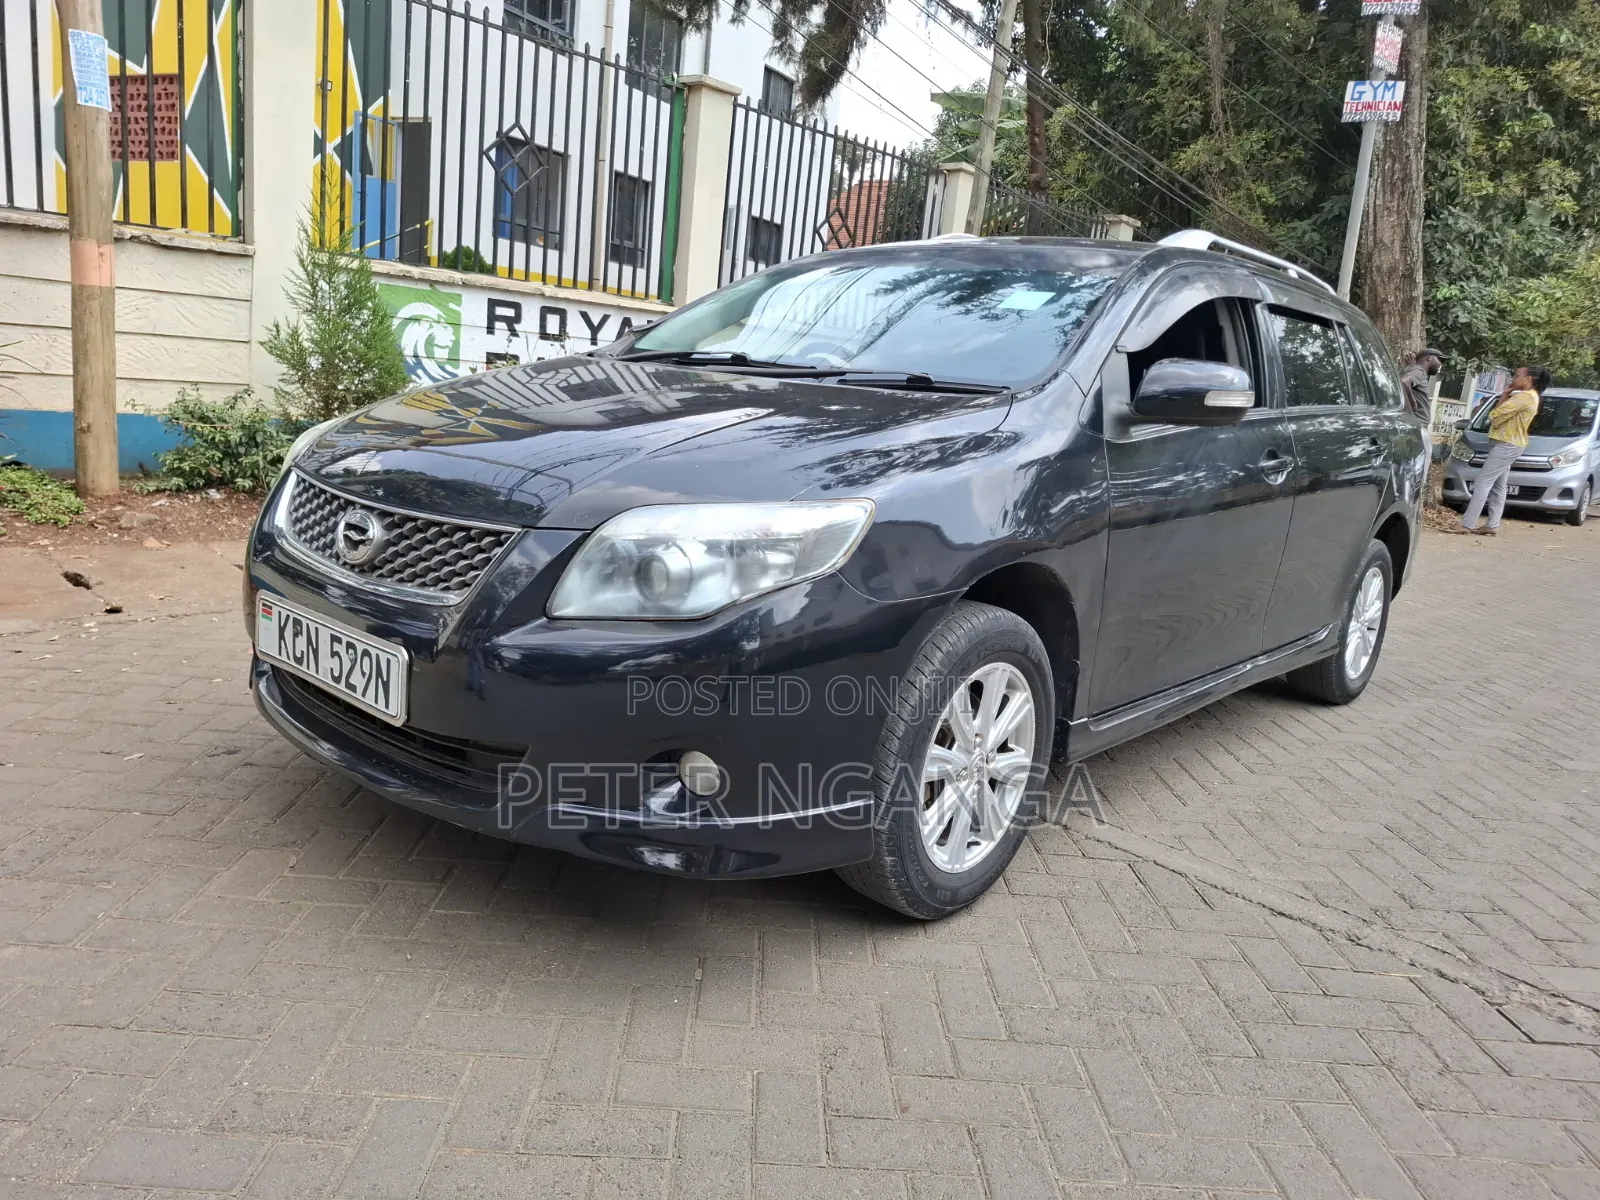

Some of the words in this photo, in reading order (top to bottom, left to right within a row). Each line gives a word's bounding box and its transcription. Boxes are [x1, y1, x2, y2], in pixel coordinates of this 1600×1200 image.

[1344, 101, 1401, 112] TECHNICIAN
[1351, 81, 1397, 101] GYM
[486, 298, 655, 347] ROYA
[278, 611, 320, 675] KCN
[329, 633, 392, 710] 529N
